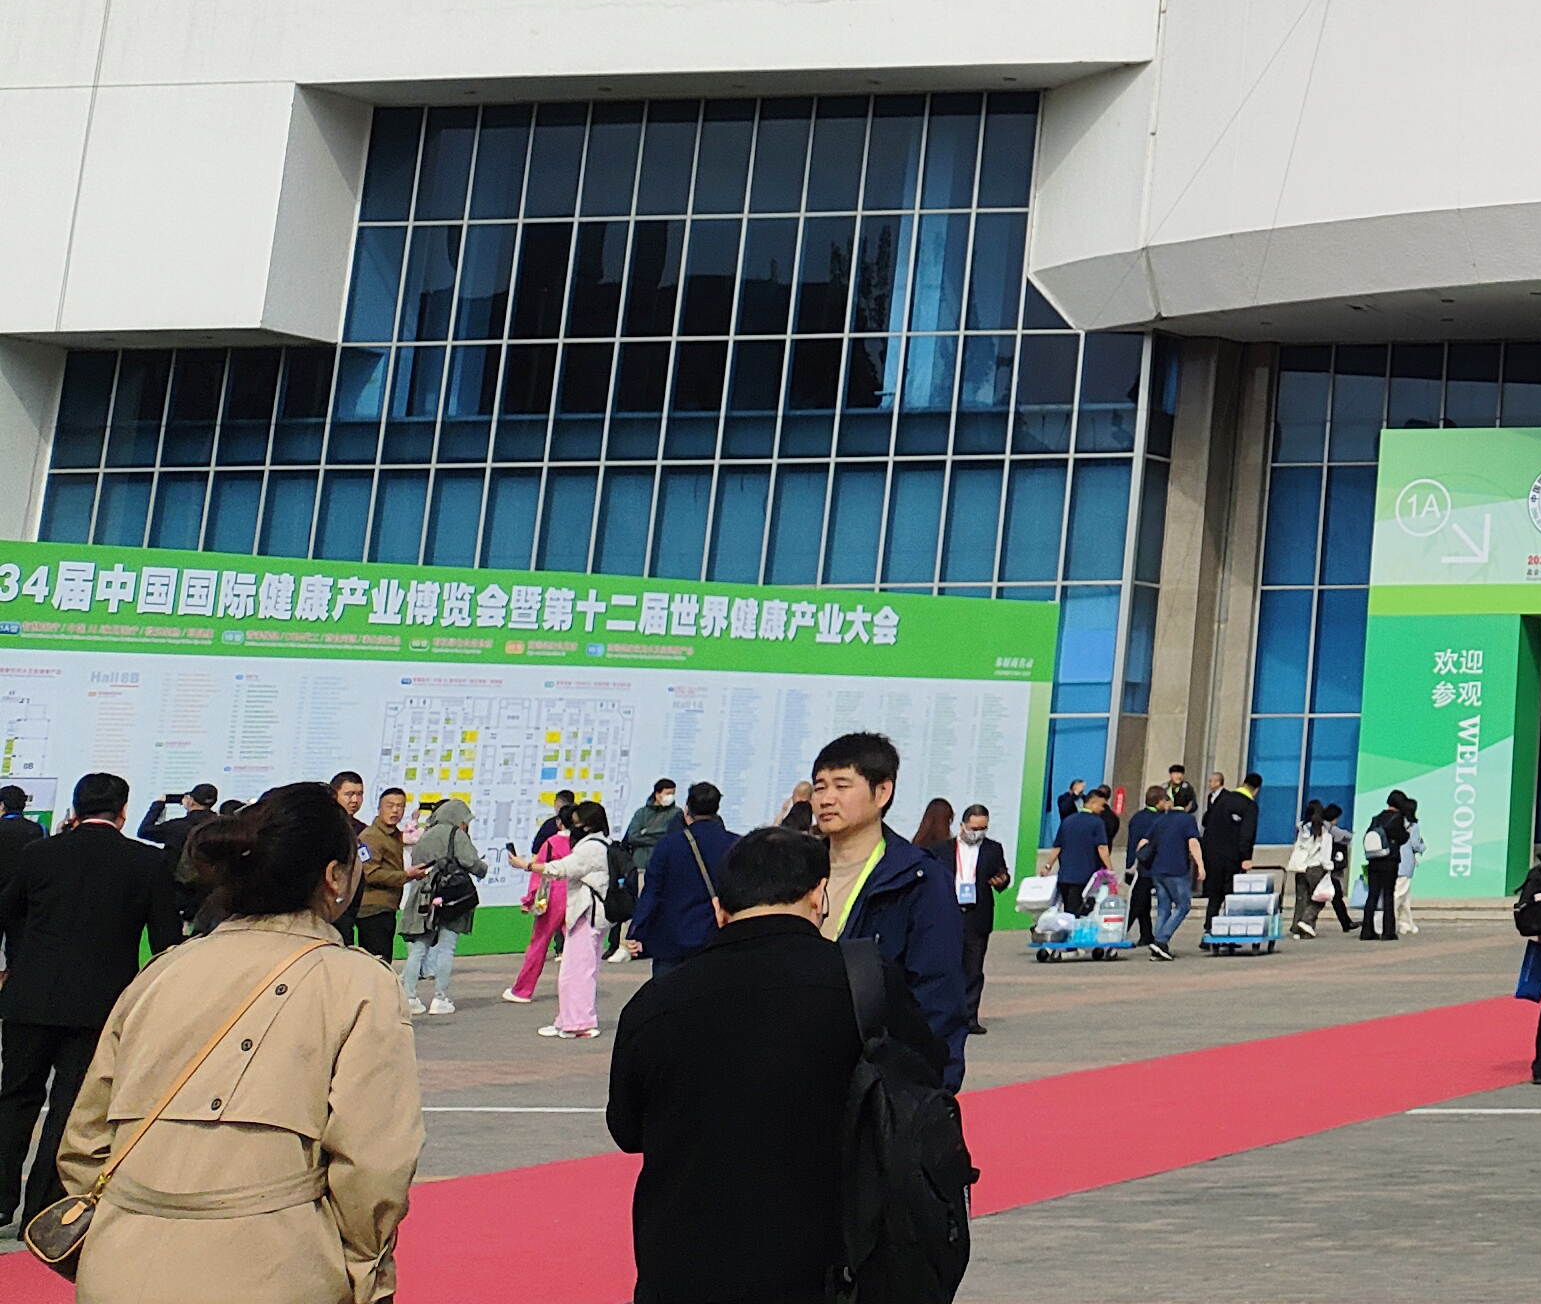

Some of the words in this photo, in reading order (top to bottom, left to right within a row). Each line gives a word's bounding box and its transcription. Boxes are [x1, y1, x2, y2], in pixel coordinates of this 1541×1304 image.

[1407, 493, 1441, 519] 1A
[1433, 649, 1484, 675] 欢迎
[91, 671, 118, 684] Hall
[120, 672, 140, 684] 8B
[1431, 681, 1482, 708] 参观
[1449, 714, 1481, 877] WELCOME
